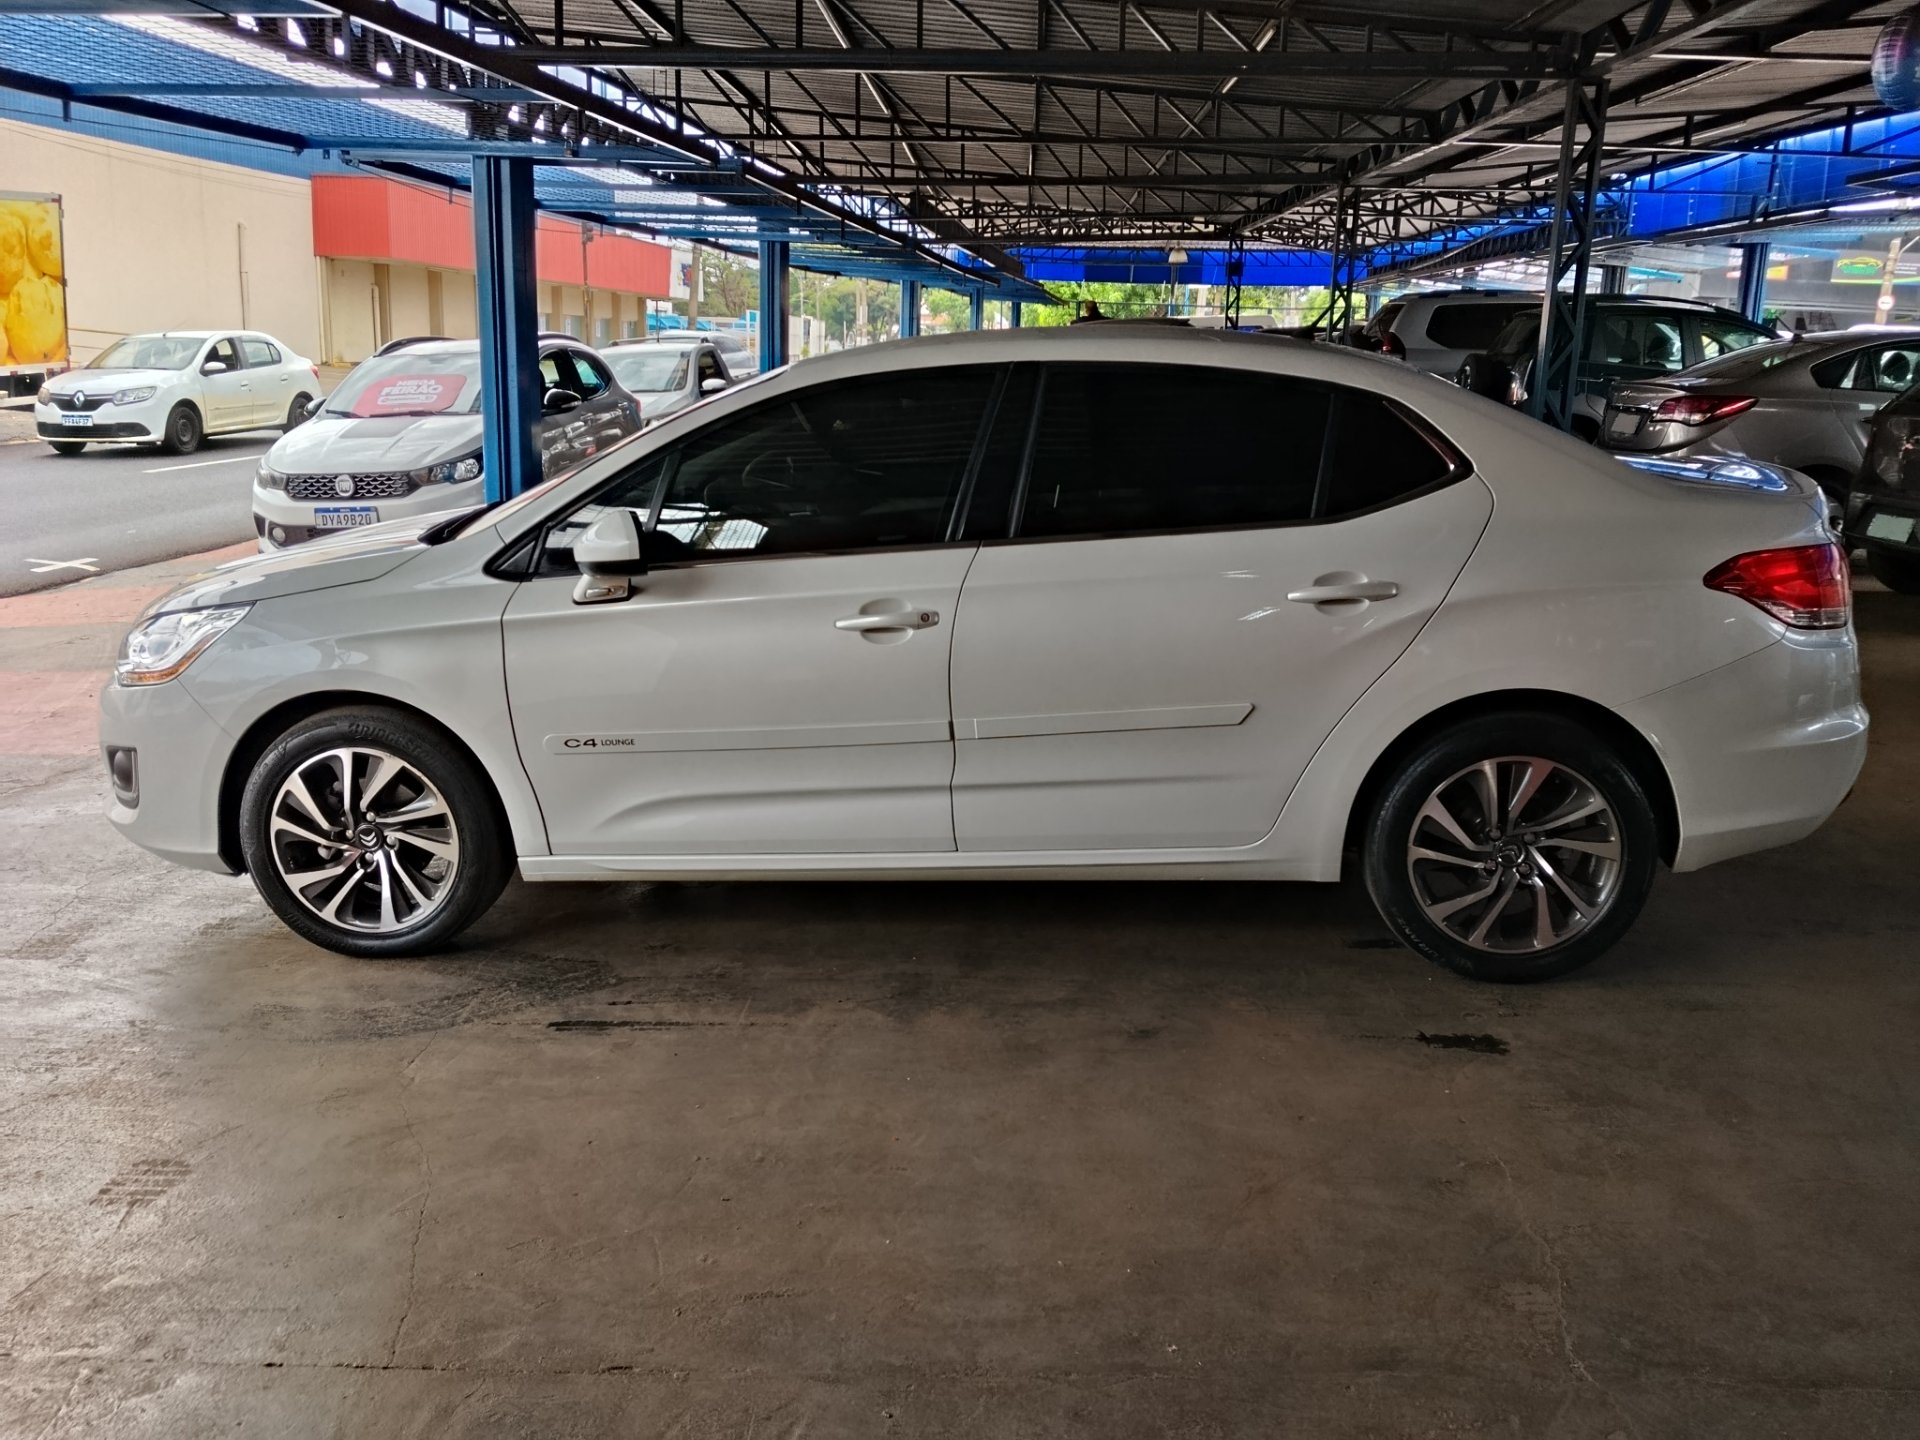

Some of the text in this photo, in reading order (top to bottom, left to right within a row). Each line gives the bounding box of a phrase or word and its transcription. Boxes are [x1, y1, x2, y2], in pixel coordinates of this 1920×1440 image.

[322, 514, 372, 526] DYA9B20
[563, 738, 636, 748] C4 LOUNGE
